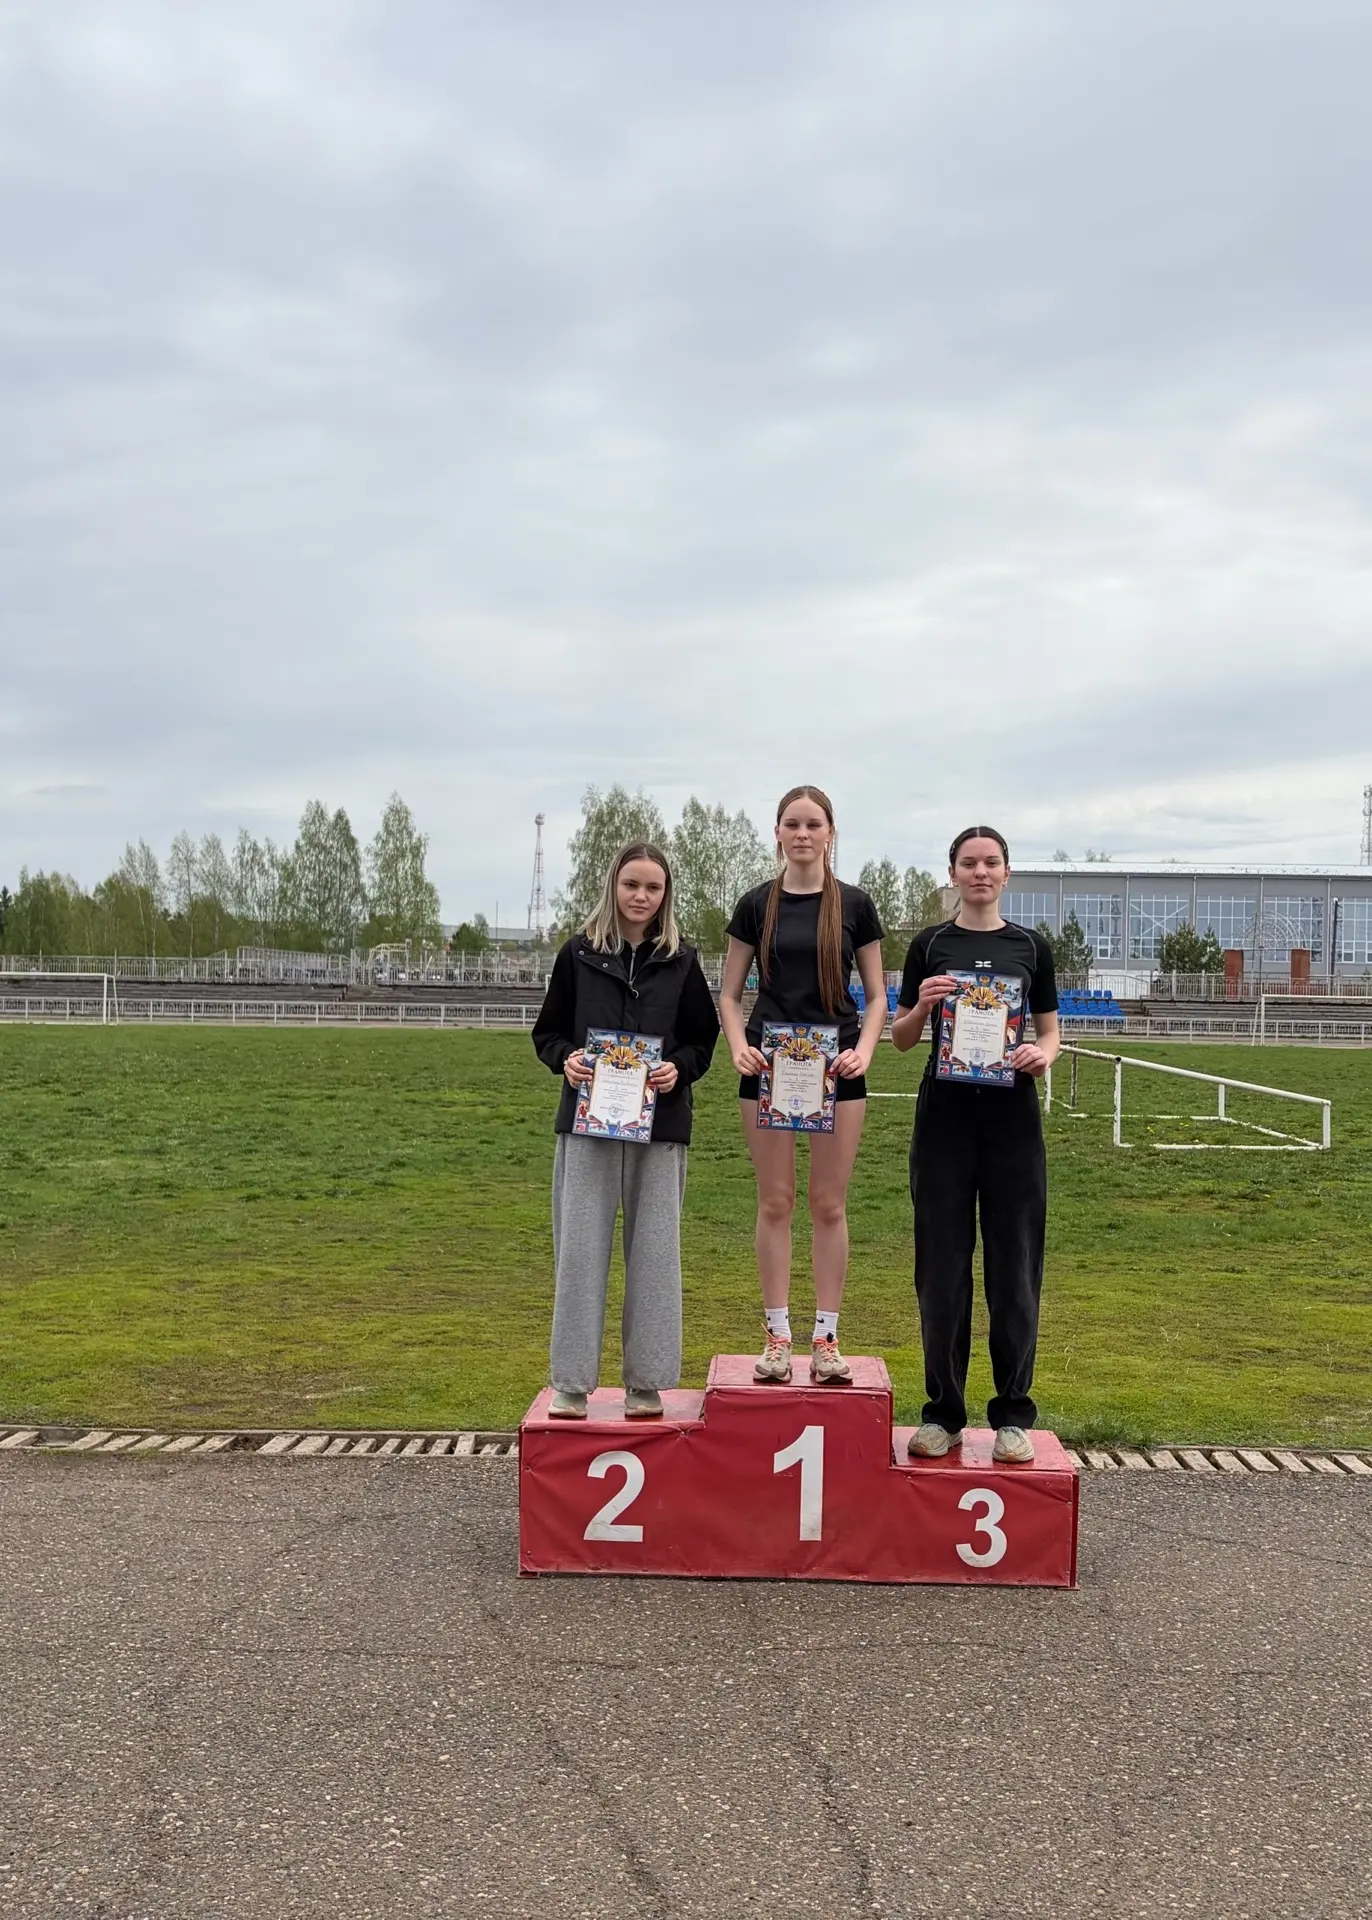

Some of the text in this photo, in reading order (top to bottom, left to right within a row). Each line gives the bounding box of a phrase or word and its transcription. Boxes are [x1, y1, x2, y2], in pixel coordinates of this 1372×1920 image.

[584, 1451, 644, 1542] 2
[774, 1426, 824, 1540] 1
[956, 1488, 1007, 1567] 3
